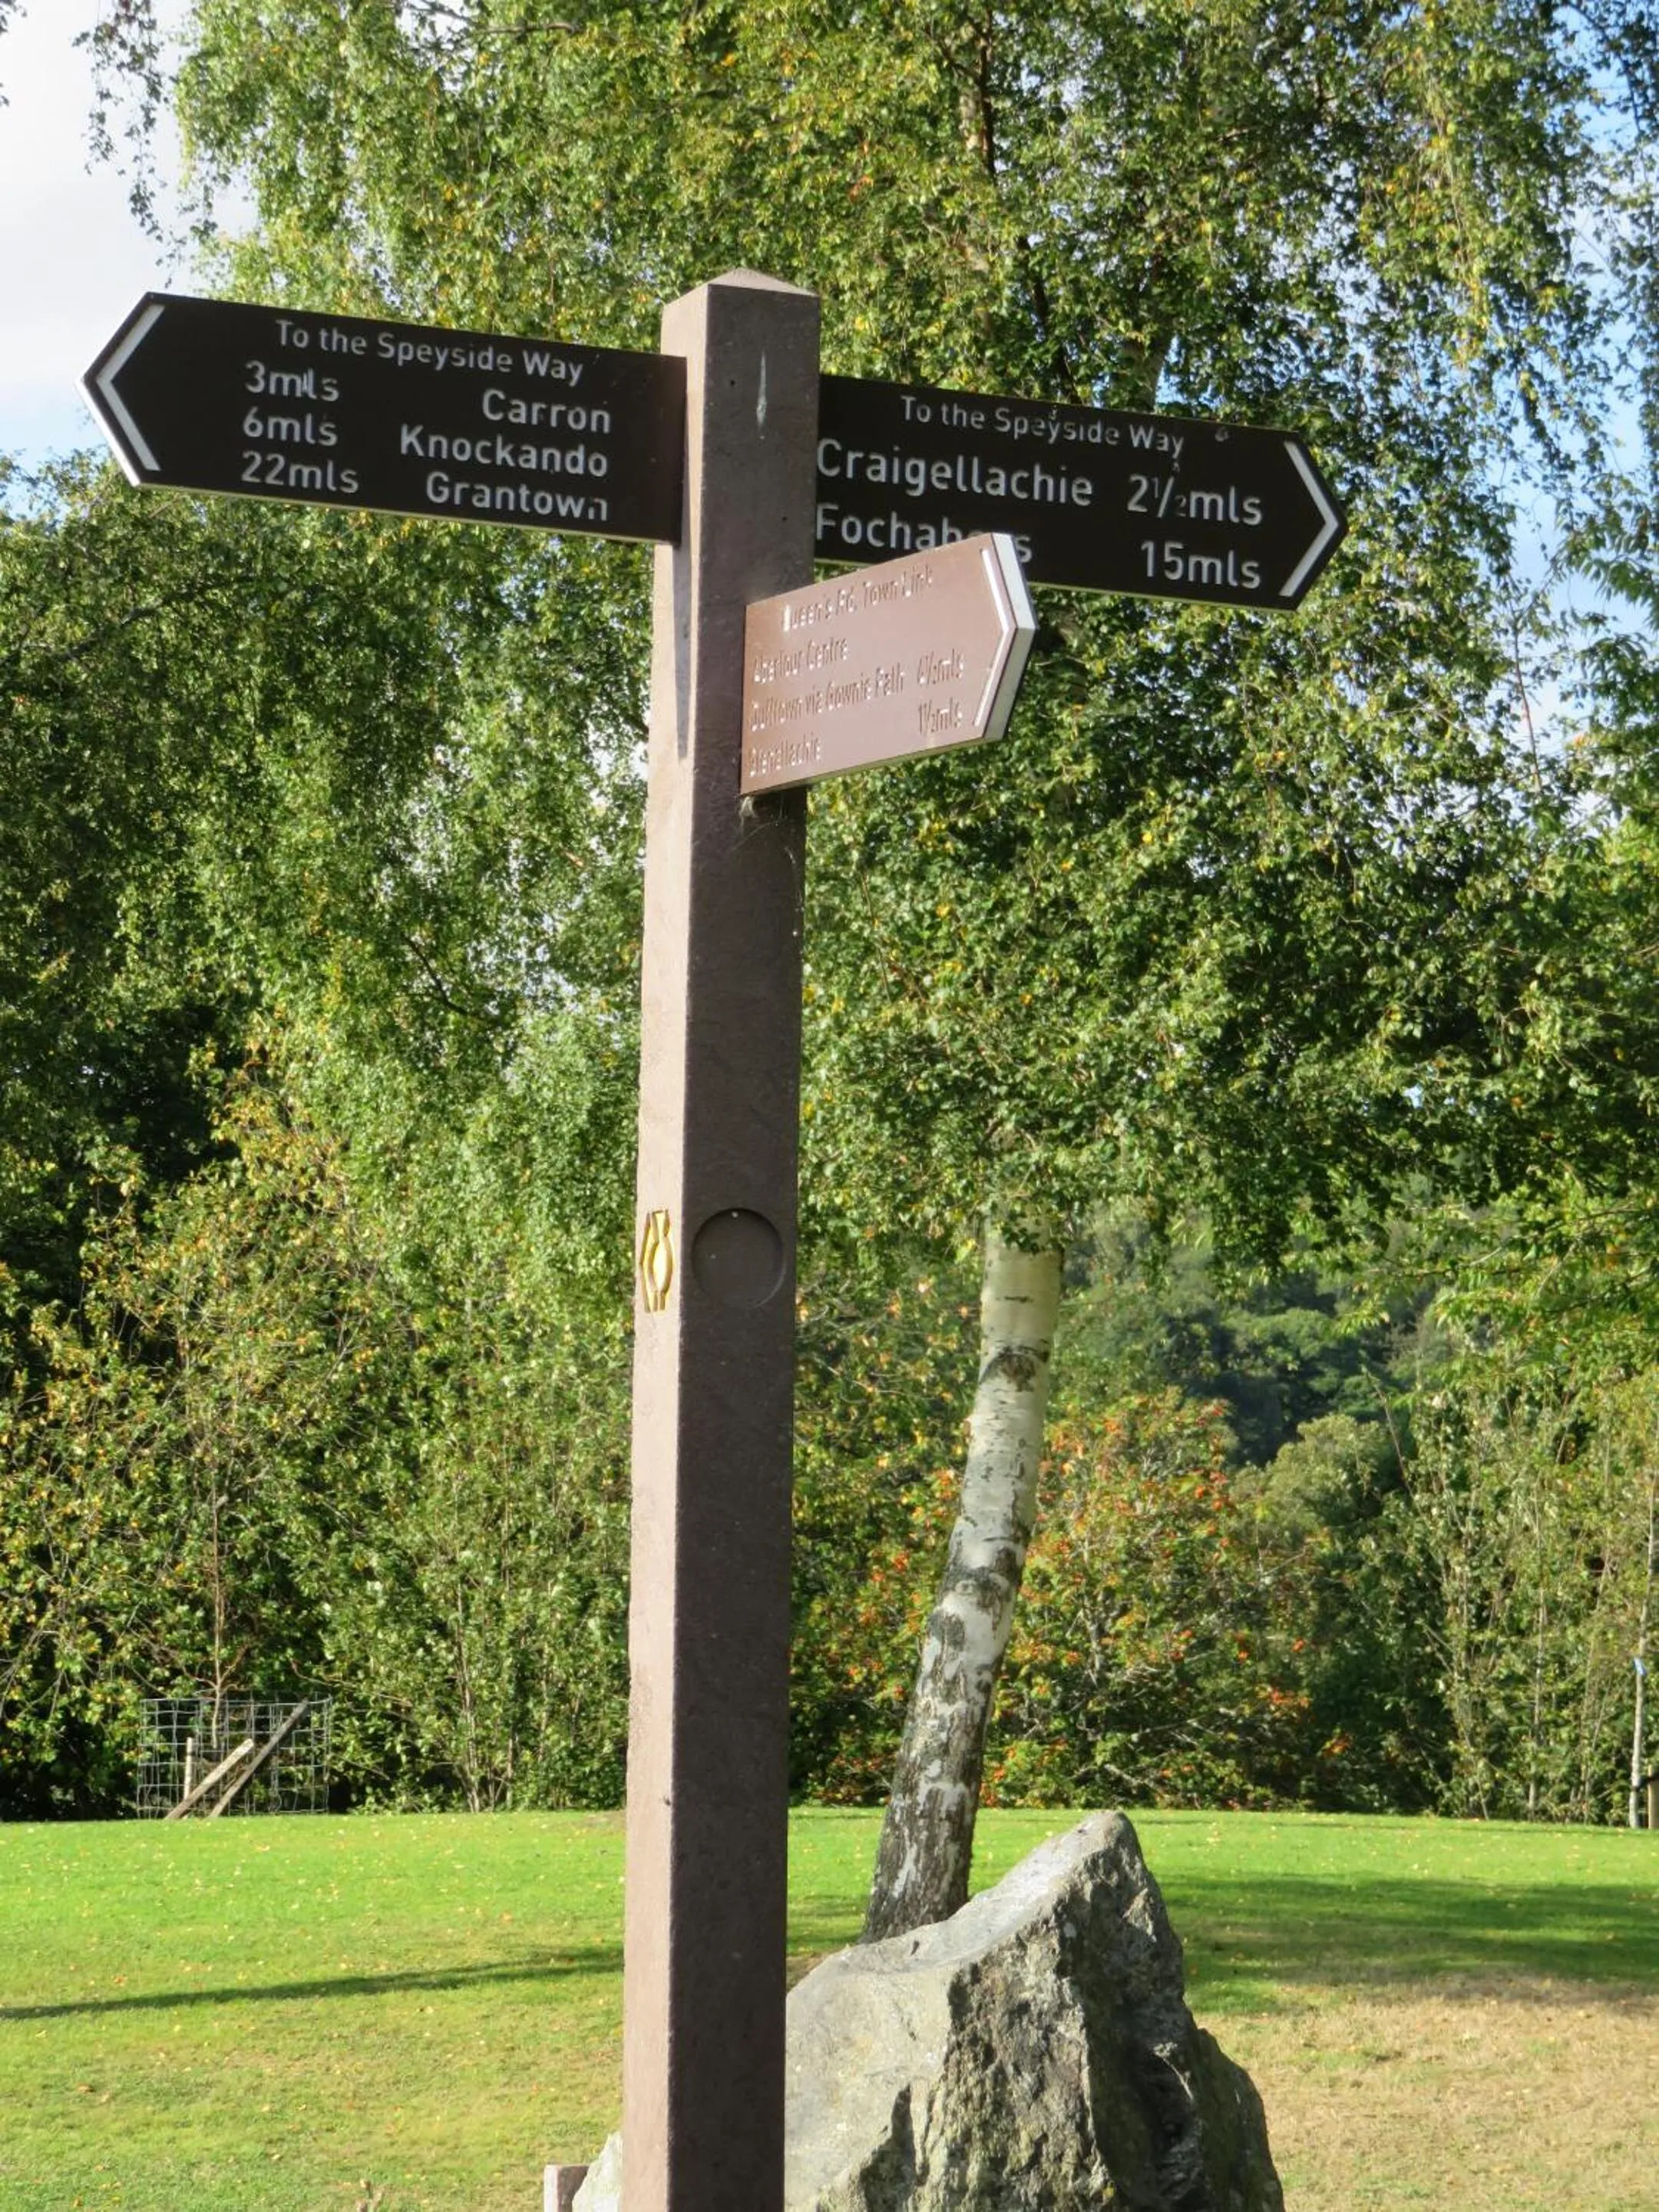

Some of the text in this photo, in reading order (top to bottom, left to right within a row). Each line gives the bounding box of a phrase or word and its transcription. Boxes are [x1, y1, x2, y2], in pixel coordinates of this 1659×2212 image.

[275, 319, 583, 387] To the Speyside Way
[244, 359, 611, 435] 3mls Carron
[901, 395, 1185, 459] To the Speyside Way
[243, 405, 608, 478] 6mls Knockando
[816, 438, 1093, 507] Craigellachie
[240, 450, 608, 522] 22mls Grantown
[815, 503, 1261, 590] Fochabs 15mls
[862, 580, 898, 609] Town
[806, 637, 848, 670] Centre
[875, 662, 905, 698] Path
